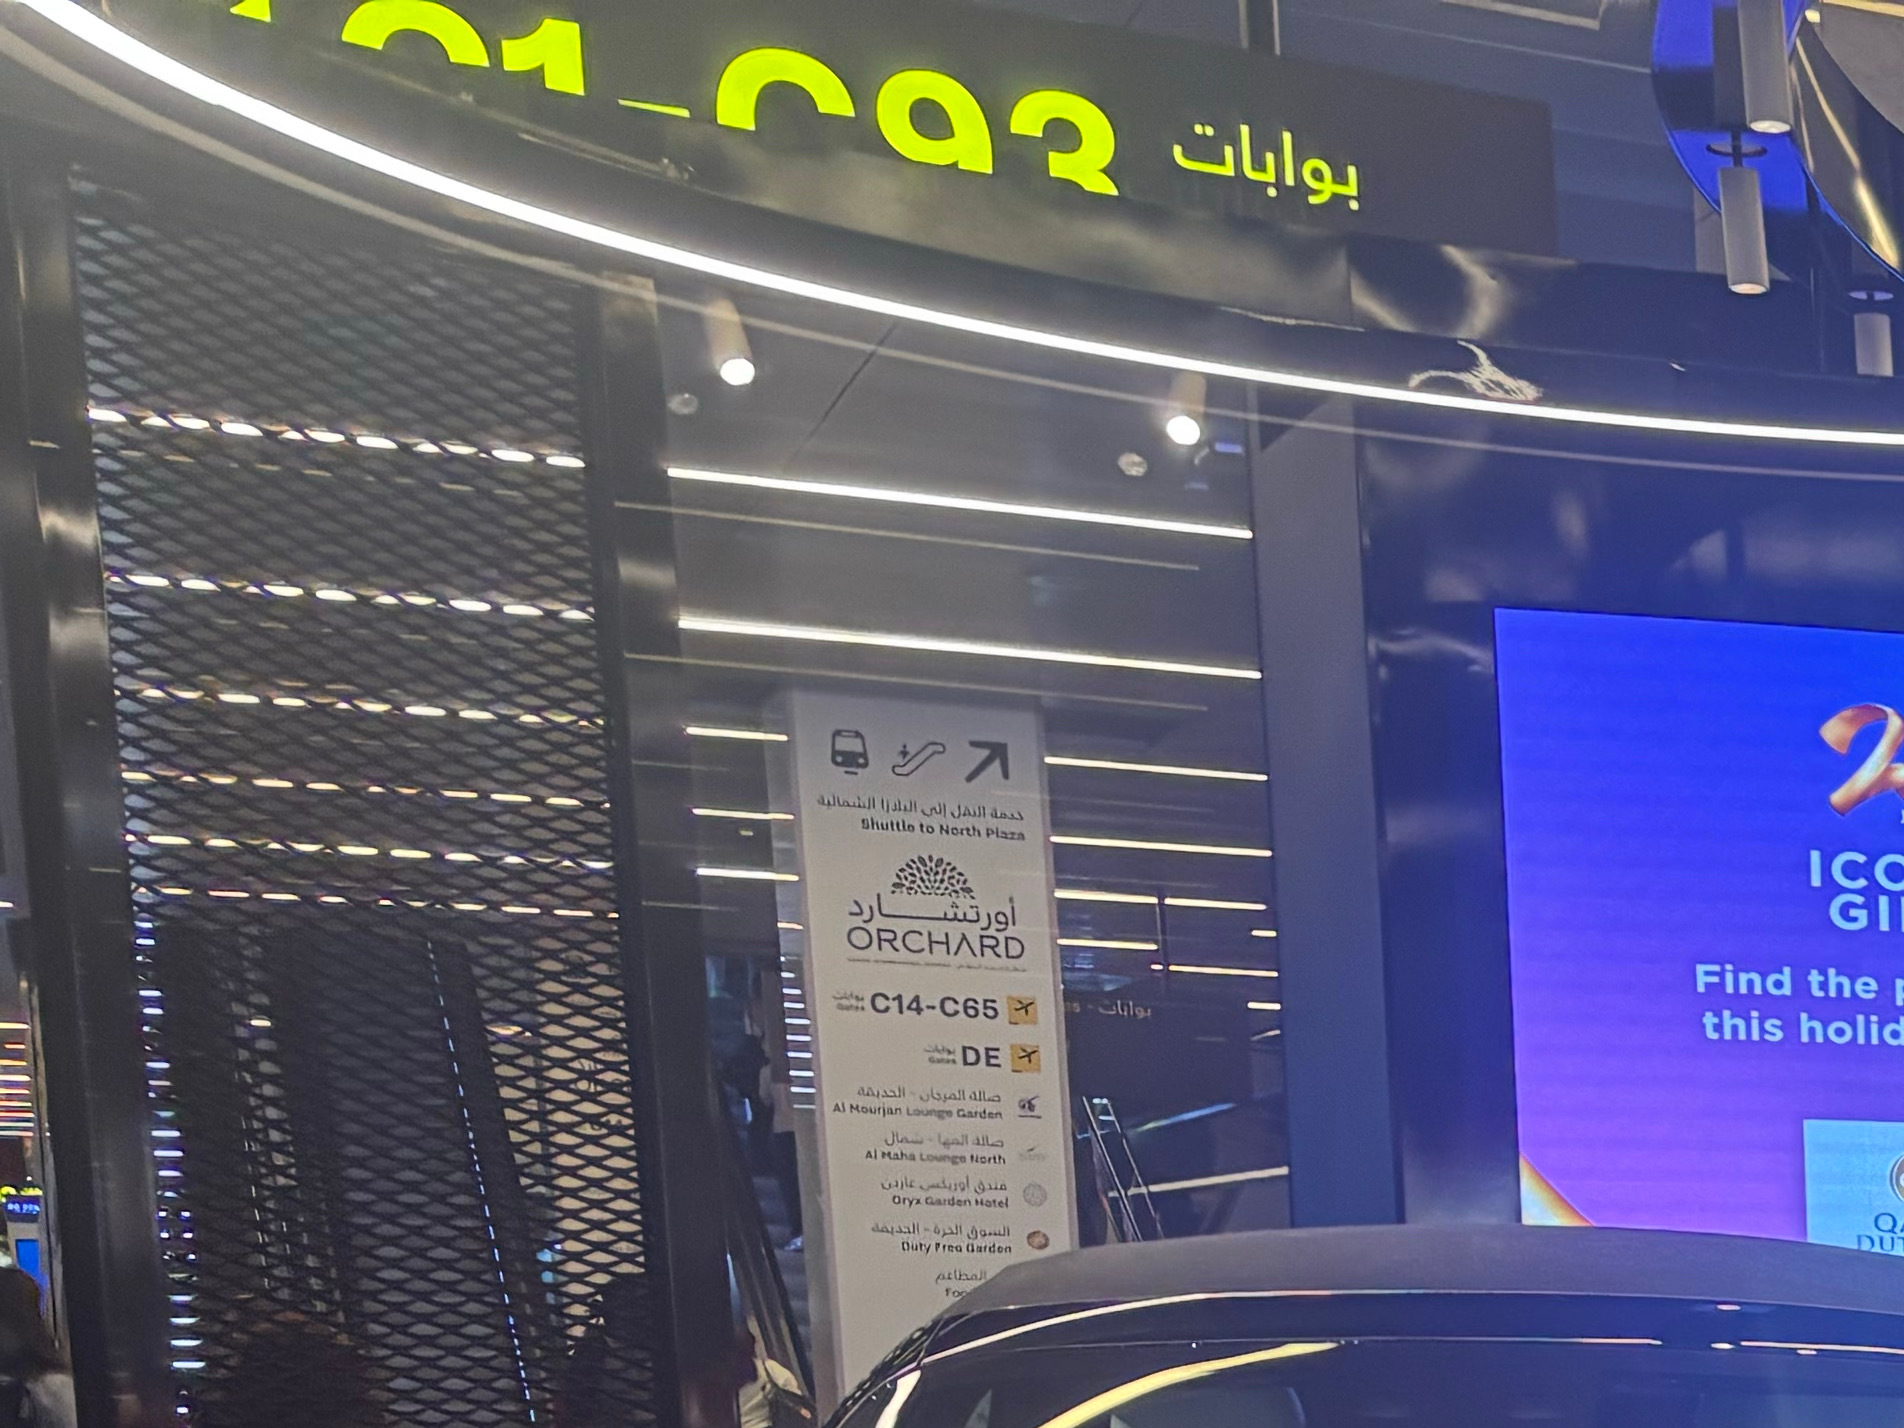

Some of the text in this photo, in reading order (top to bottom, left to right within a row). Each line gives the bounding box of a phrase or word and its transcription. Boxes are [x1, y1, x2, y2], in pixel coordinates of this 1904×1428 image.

[1172, 123, 1360, 211] بوابات
[861, 817, 1026, 842] Shuttle to North Plaza
[848, 893, 1016, 932] أورتشارد
[847, 926, 1026, 959] ORCHARD
[1695, 963, 1792, 997] Find
[1807, 967, 1879, 1000] the
[870, 992, 999, 1020] C14-C65
[1703, 1009, 1784, 1043] this
[961, 1045, 1002, 1068] DE
[833, 1102, 1003, 1120] Al Mourjan Lounge Garden
[865, 1149, 877, 1160] Al
[970, 1152, 1006, 1165] North
[892, 1195, 1009, 1209] Oryx Garden Hotel
[901, 1241, 1012, 1256] Duty Free Garden
